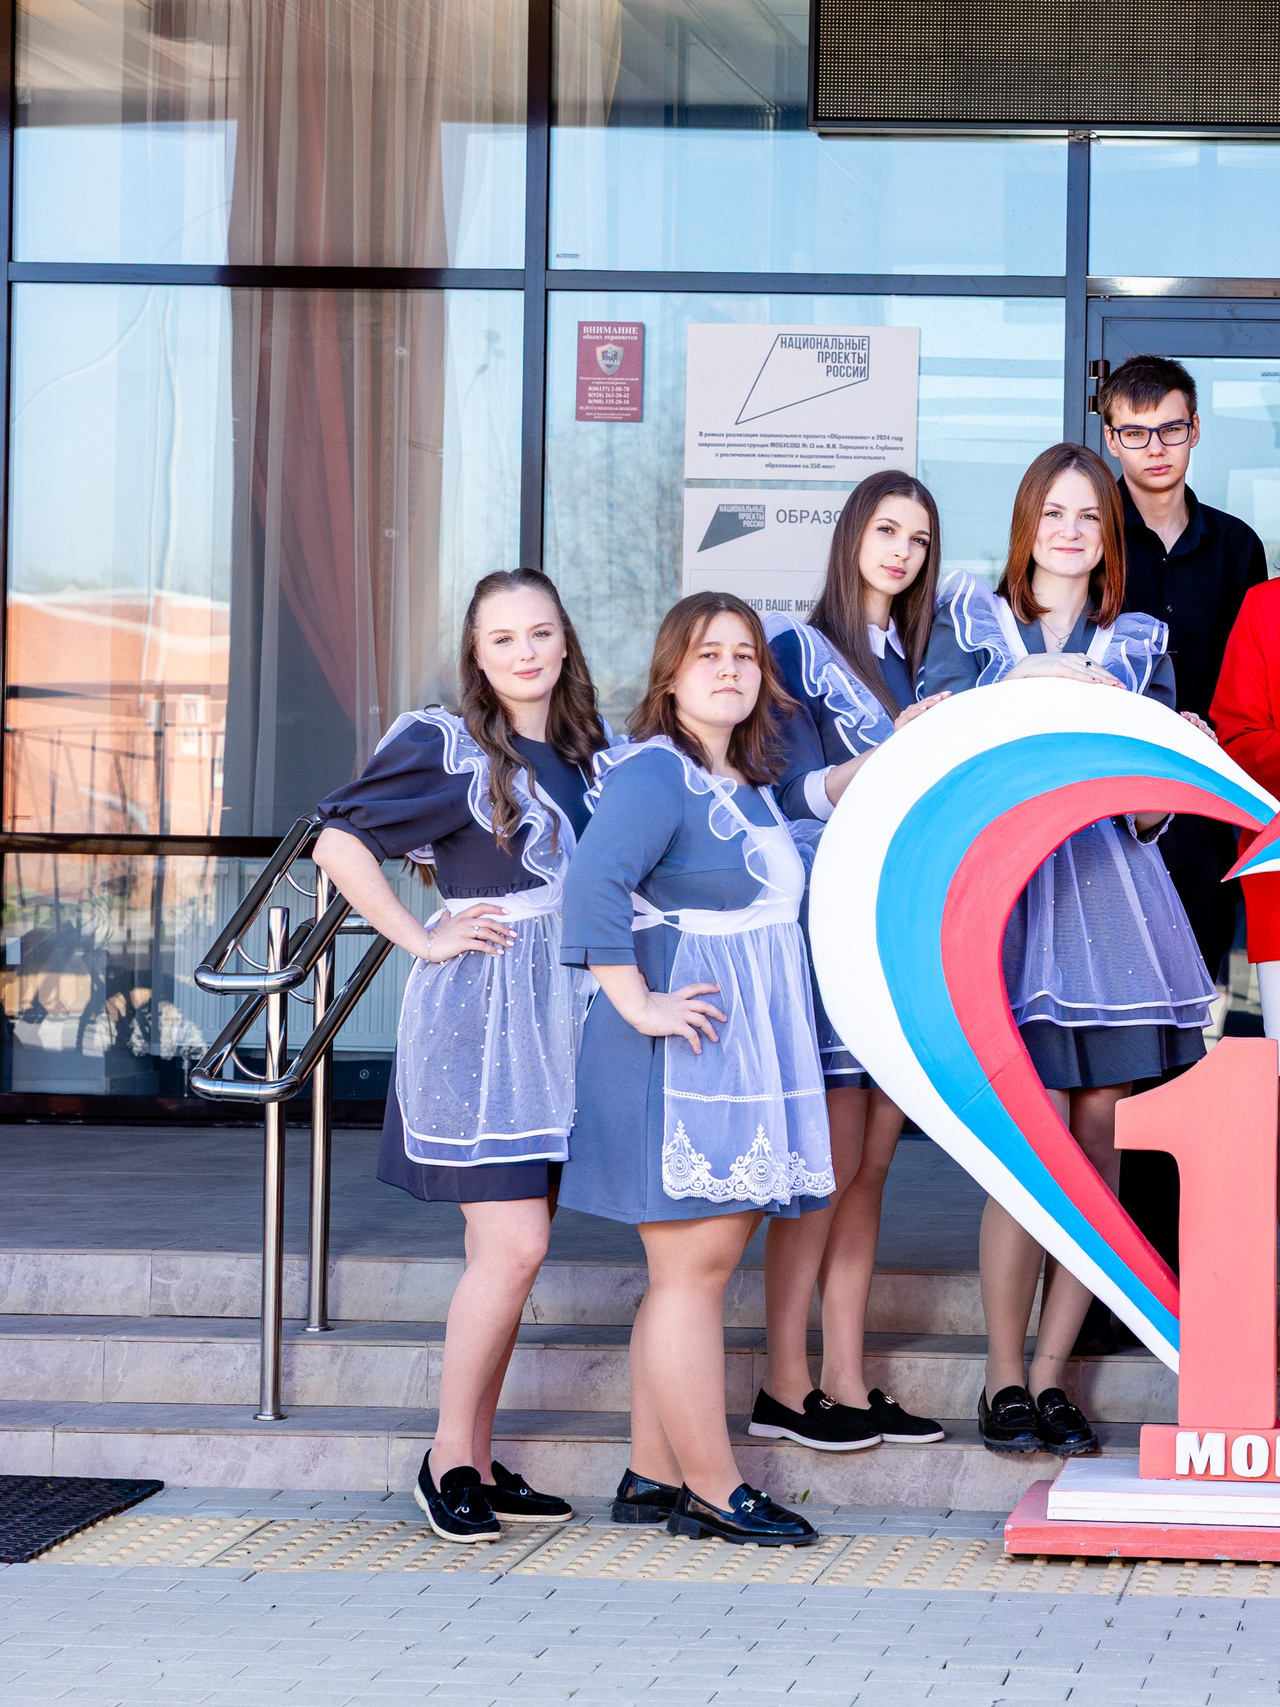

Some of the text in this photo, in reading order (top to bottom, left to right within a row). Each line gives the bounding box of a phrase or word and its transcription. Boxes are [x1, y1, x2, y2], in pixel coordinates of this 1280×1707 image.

[583, 326, 638, 335] ВНИМАНИЕ
[604, 334, 638, 342] охраняется
[780, 336, 867, 350] НАЦИОНАЛЬНЫЕ
[817, 351, 867, 364] ПРОЕКТЫ
[826, 365, 866, 378] РОССИИ
[719, 505, 764, 513] НАЦИОНАЛЬНЫЕ
[738, 512, 764, 520] ПРОЕКТЫ
[766, 599, 793, 612] ВАШЕ
